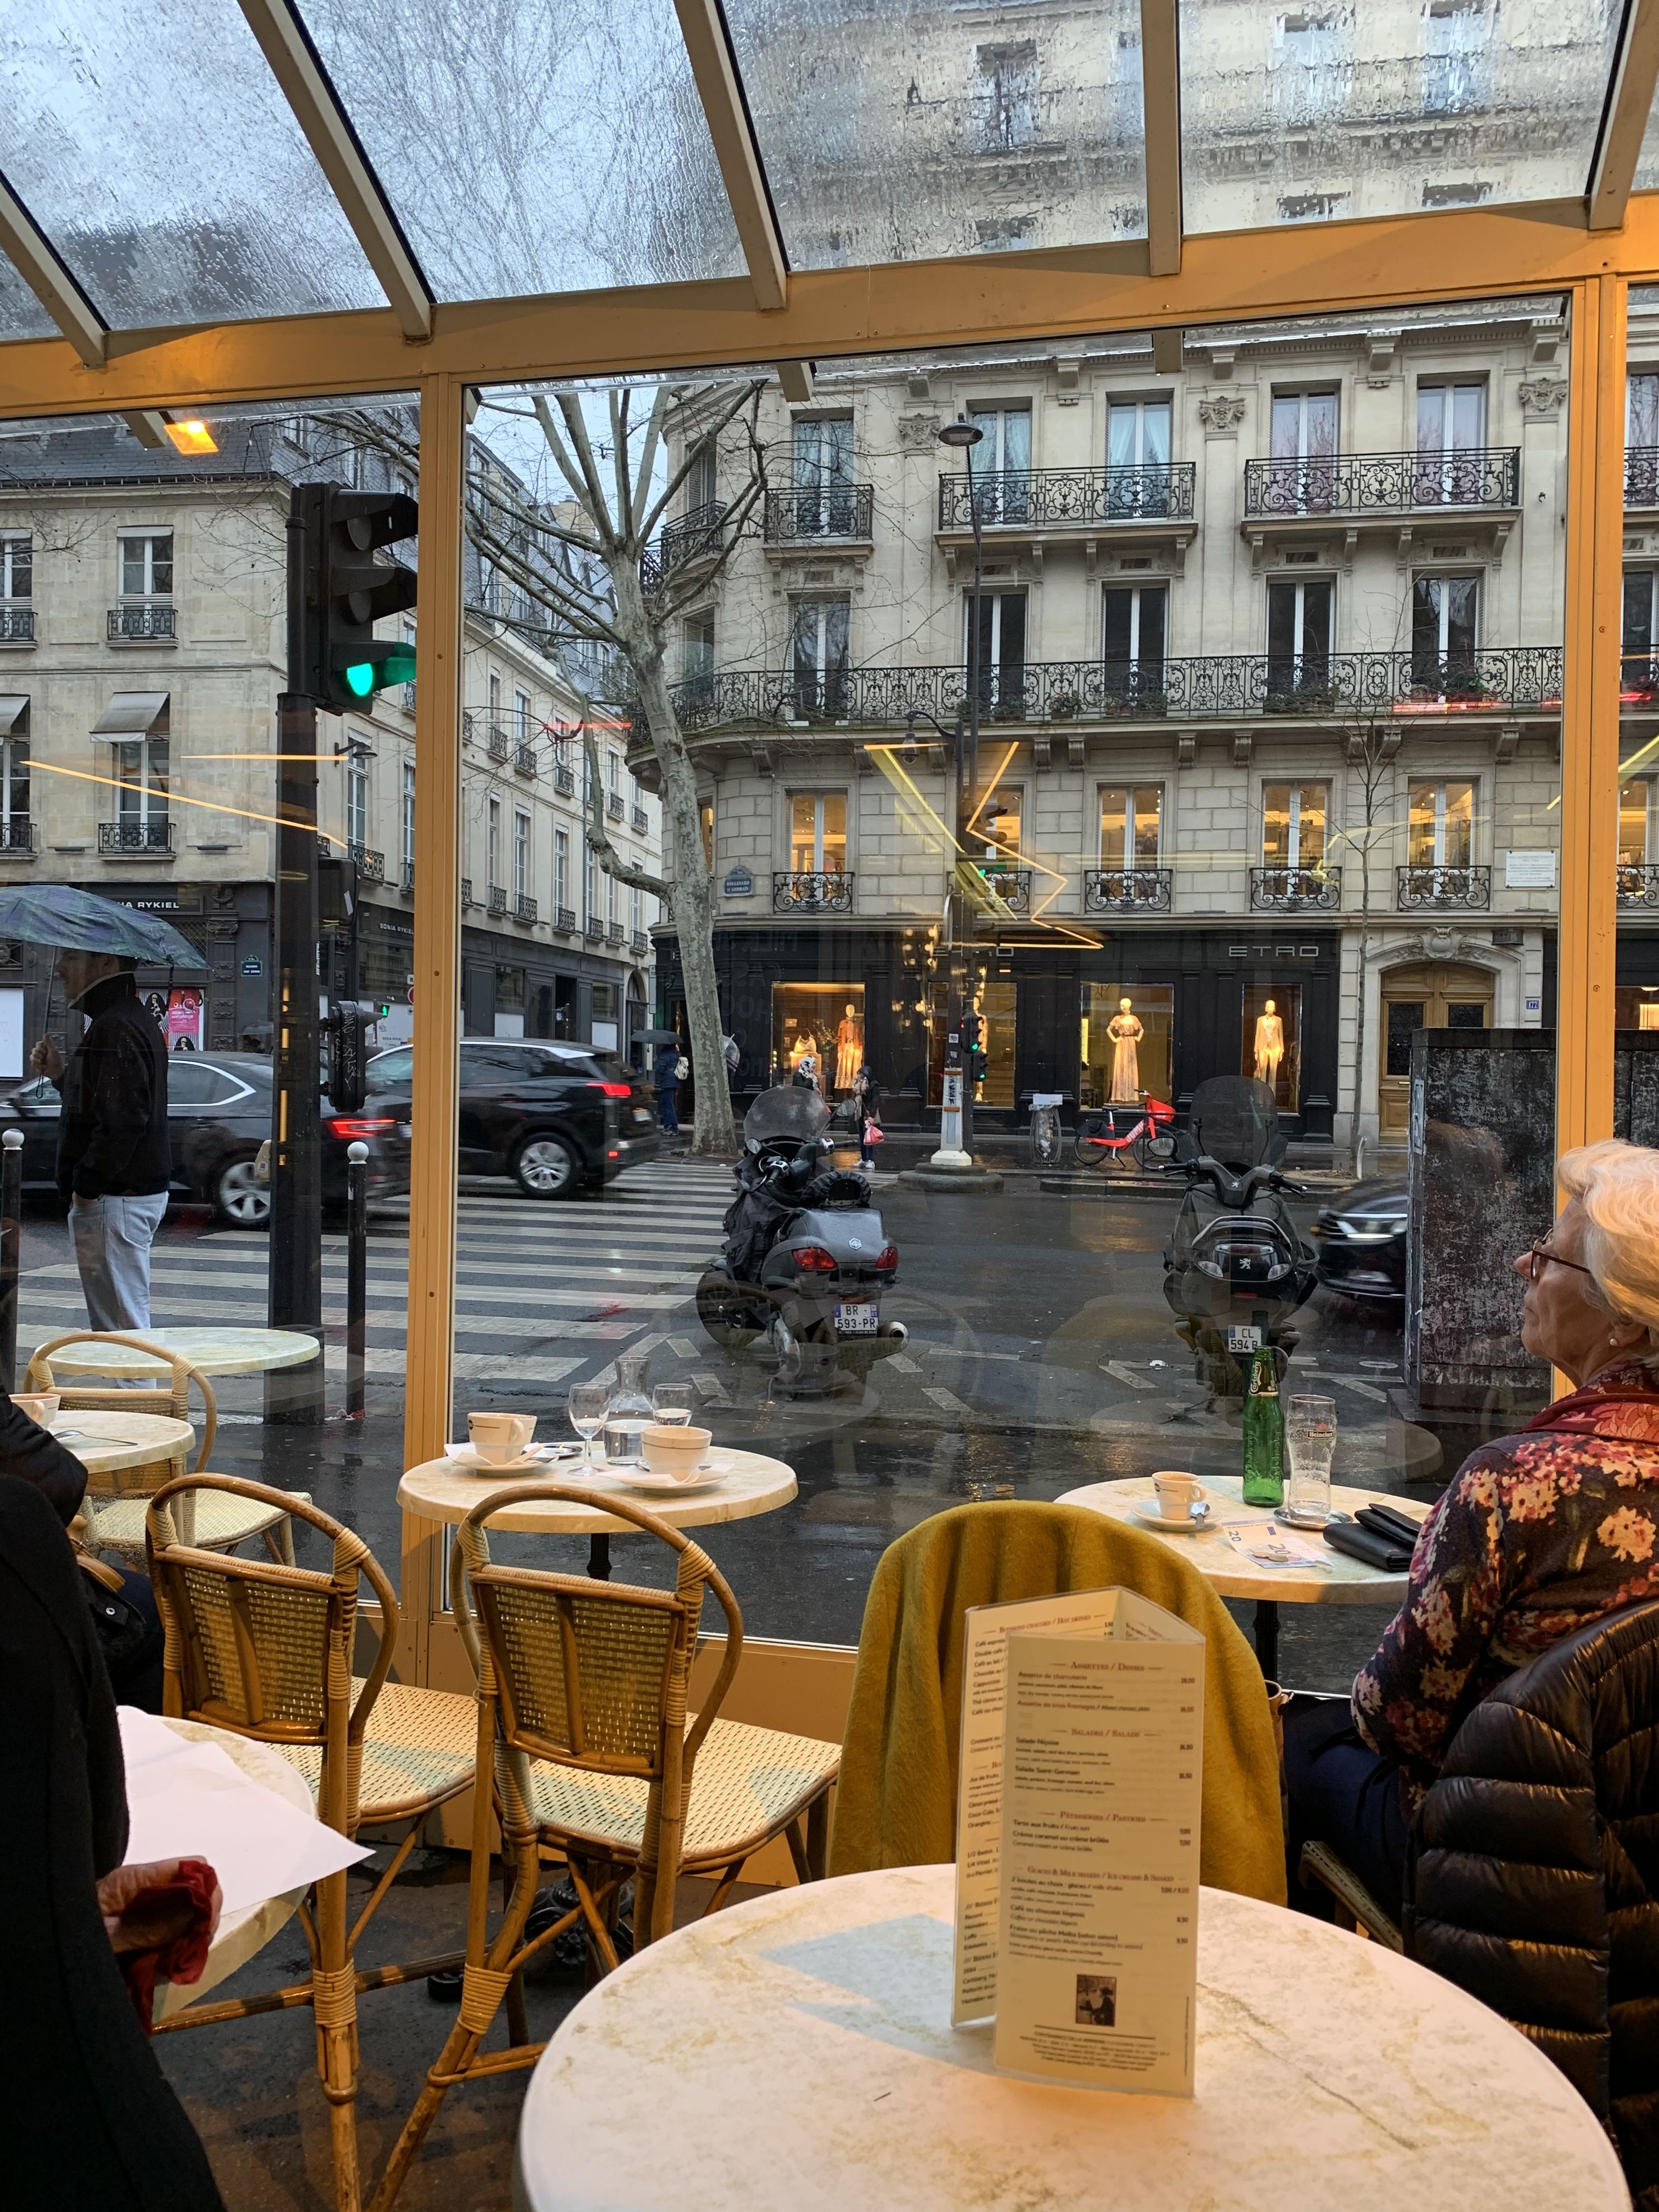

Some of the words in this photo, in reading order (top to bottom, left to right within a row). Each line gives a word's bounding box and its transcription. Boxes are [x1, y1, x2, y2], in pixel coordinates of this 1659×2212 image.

[380, 923, 396, 931] SONIA
[1228, 946, 1319, 957] ETRO
[837, 1318, 876, 1328] 593-PR
[1242, 1328, 1254, 1338] CL
[1231, 1340, 1249, 1350] 594
[1250, 1361, 1261, 1393] Carlsberg
[1228, 1531, 1242, 1542] 20
[1267, 1543, 1291, 1555] 20
